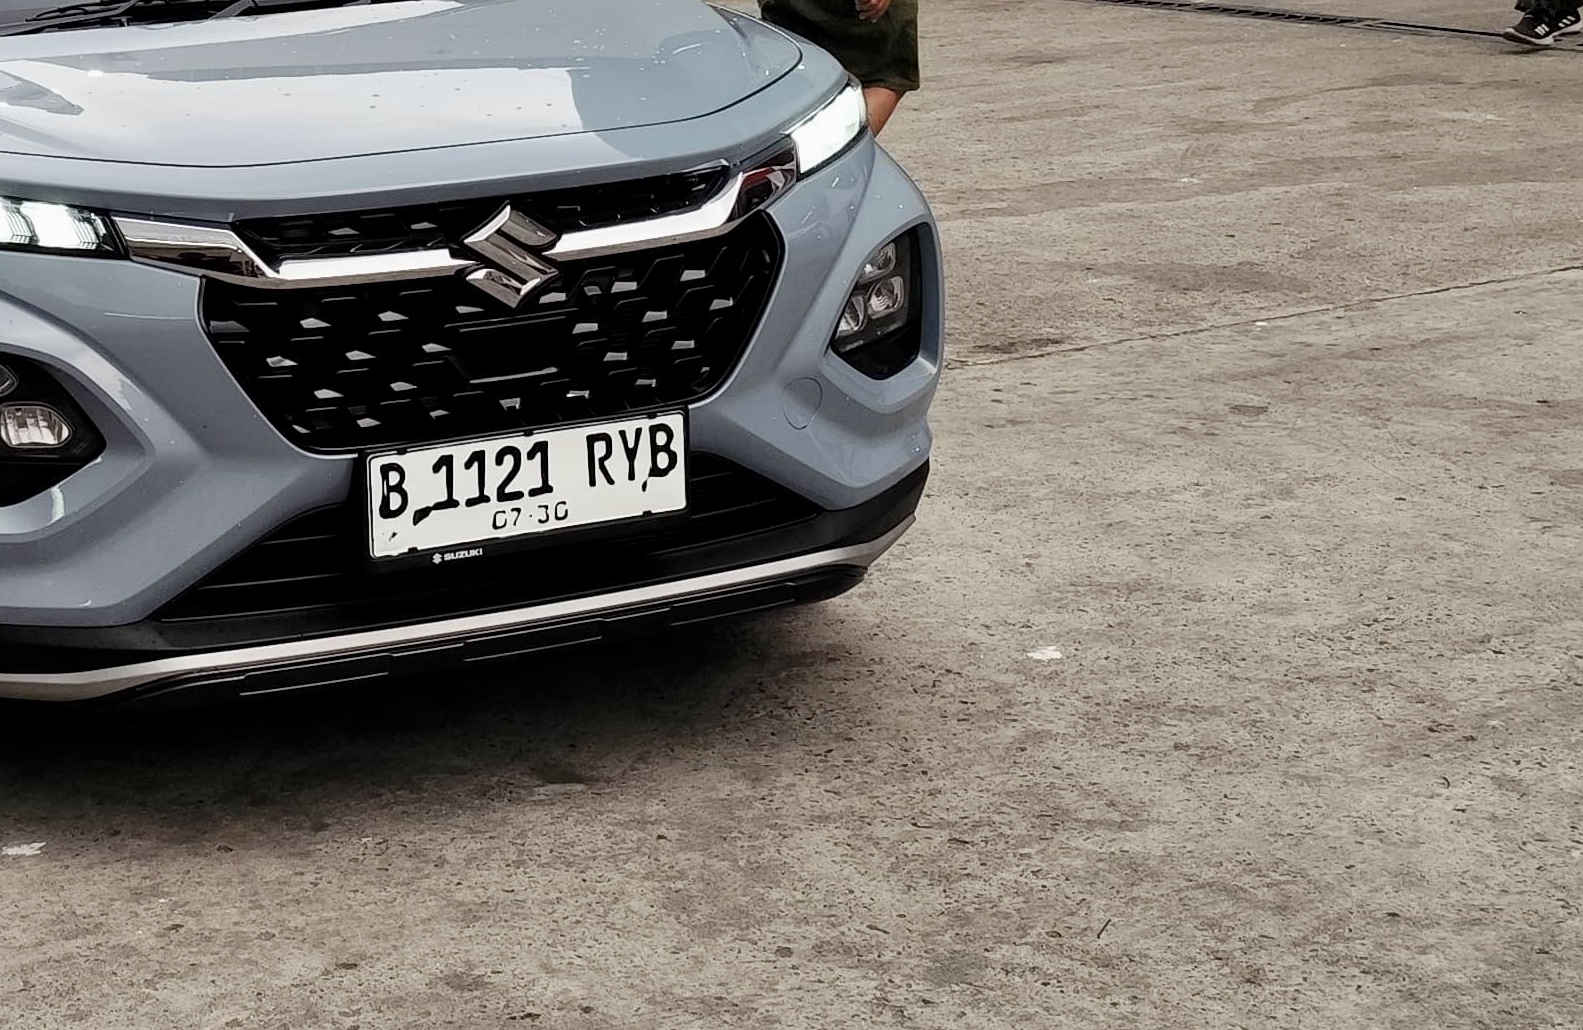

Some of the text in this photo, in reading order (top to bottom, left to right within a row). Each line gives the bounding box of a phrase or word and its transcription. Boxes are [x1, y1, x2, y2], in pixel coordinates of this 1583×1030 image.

[378, 422, 678, 520] B 1121 RYB
[443, 547, 484, 562] SUZUKI
